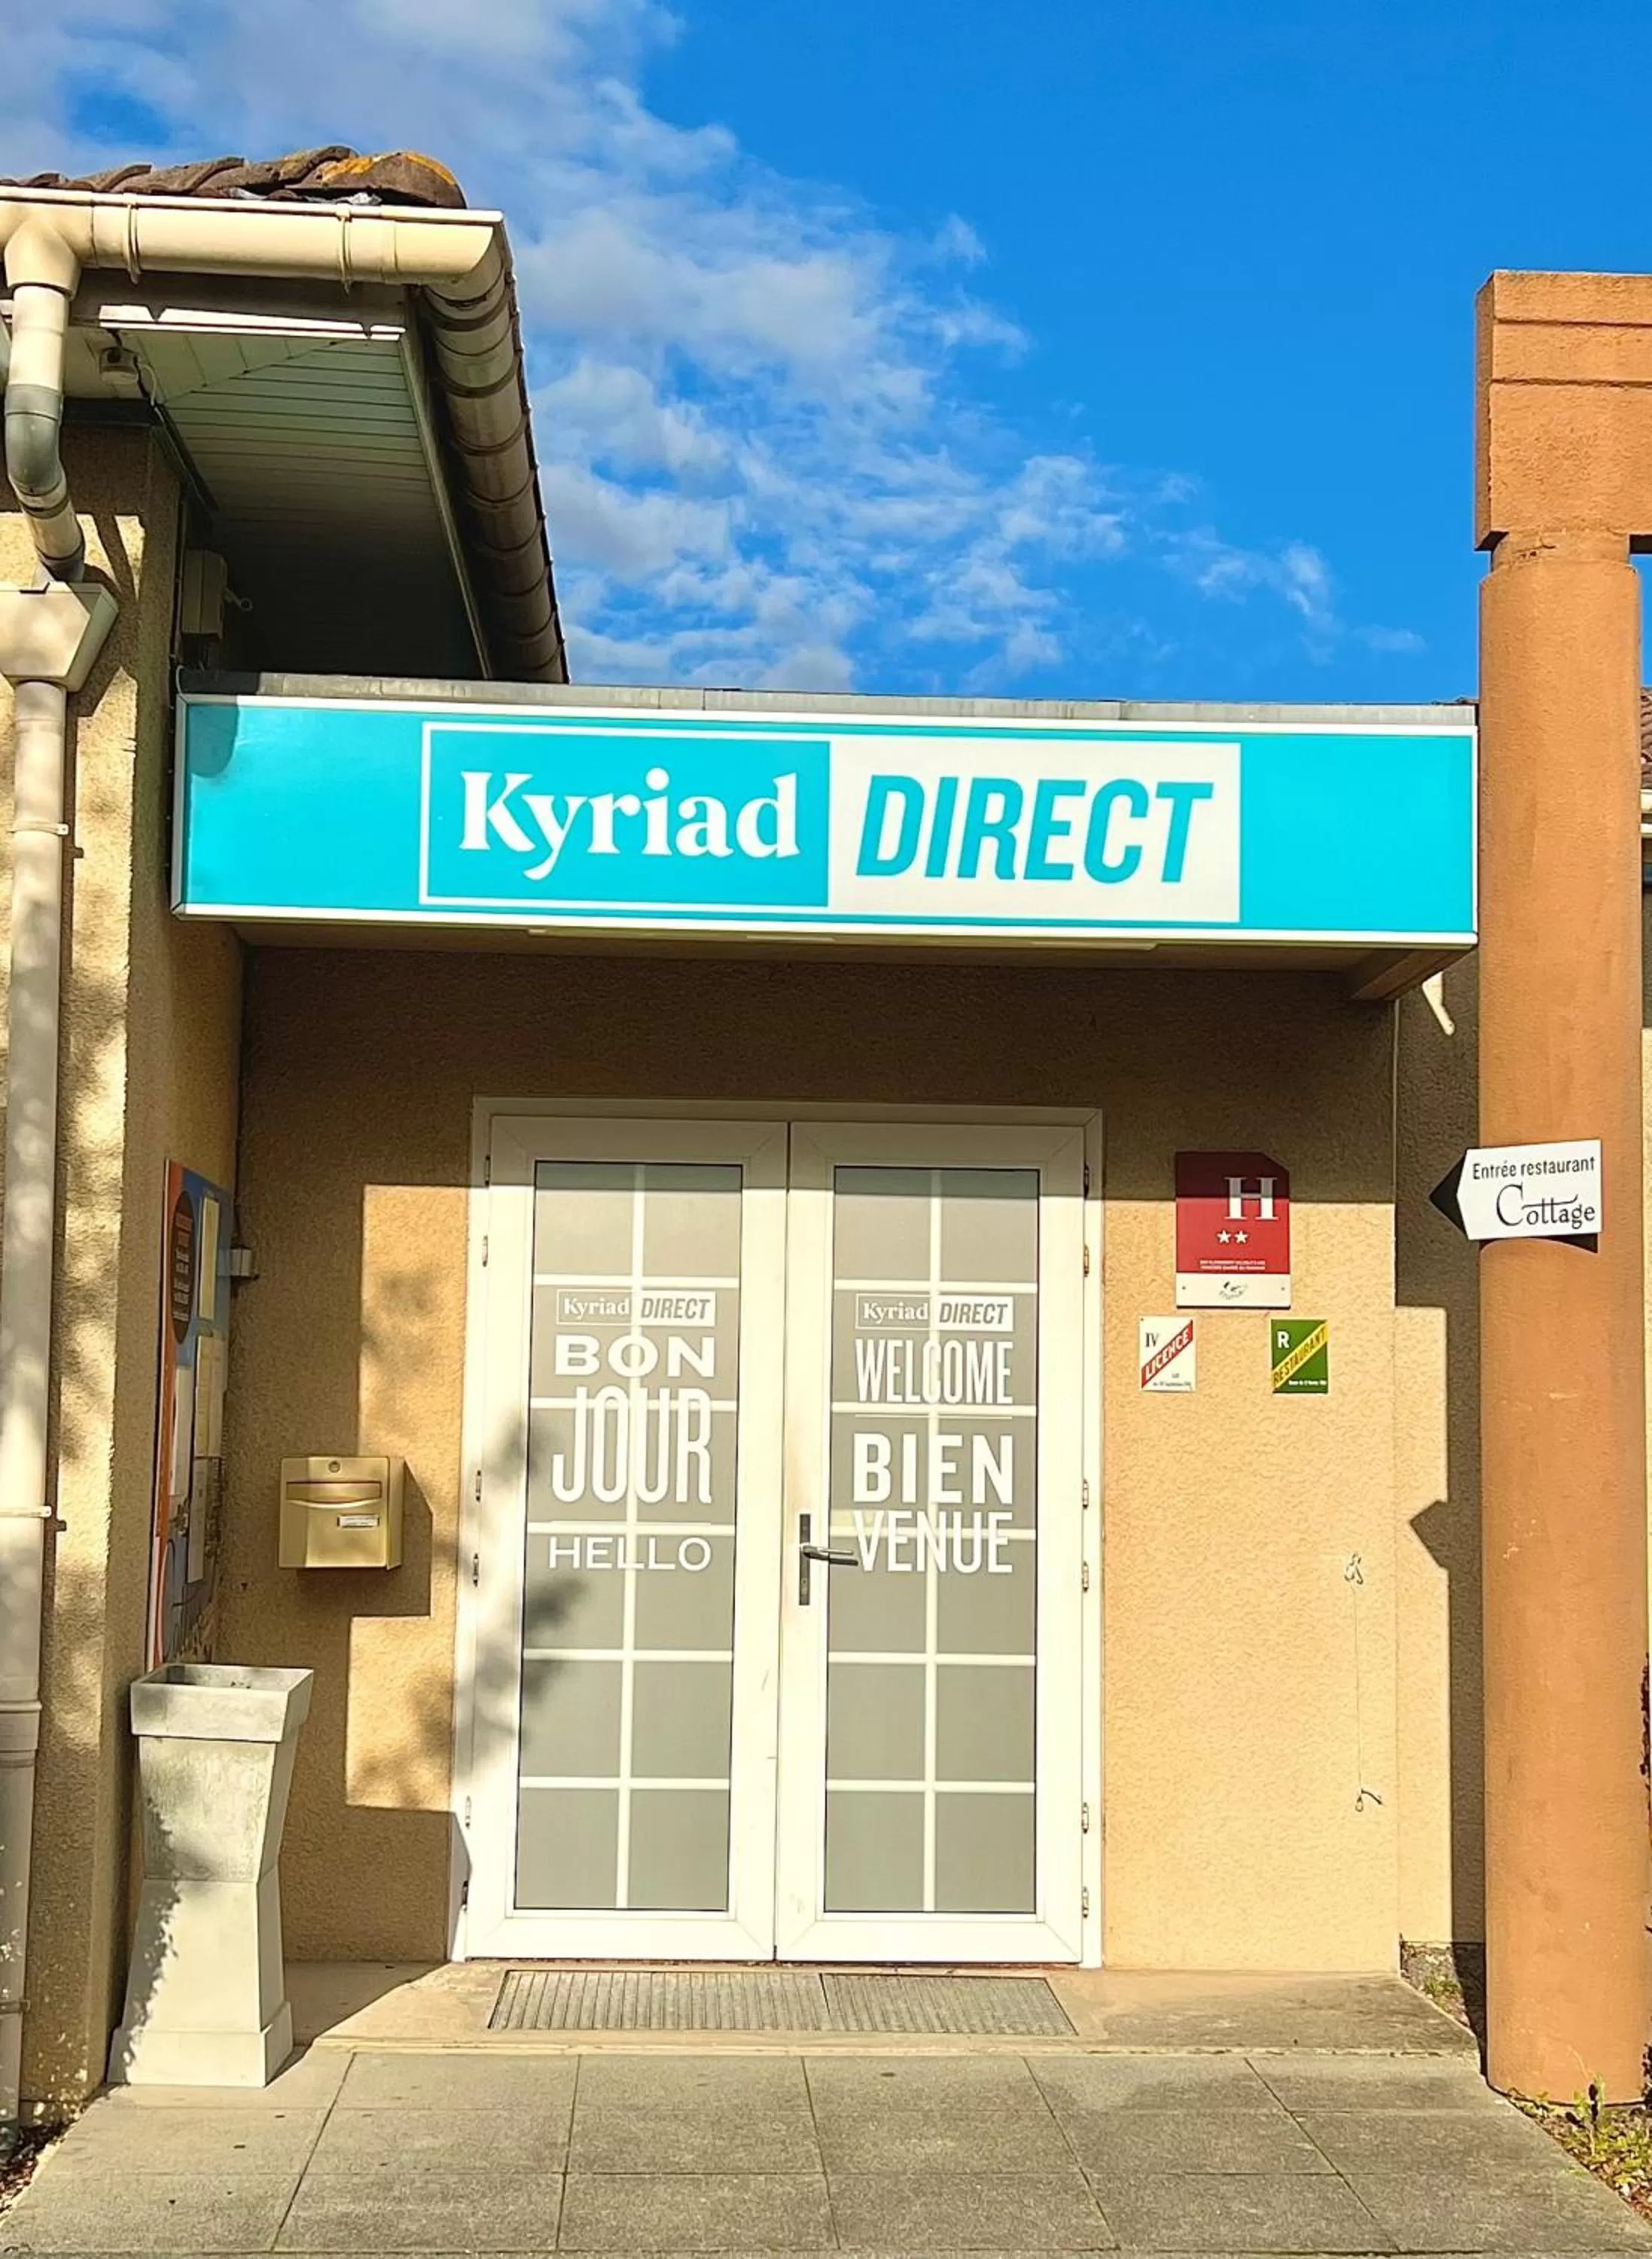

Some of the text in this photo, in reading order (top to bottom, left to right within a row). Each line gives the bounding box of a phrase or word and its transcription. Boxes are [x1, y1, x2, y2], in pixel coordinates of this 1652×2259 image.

[460, 767, 1213, 885] Kyriad DIRECT
[1473, 1156, 1595, 1180] Entrée restaurant
[1224, 1177, 1279, 1221] H
[1496, 1182, 1596, 1230] Cottage
[564, 1297, 712, 1320] Kyriad DIRECT
[863, 1301, 1008, 1325] Kyriad DIRECT
[554, 1334, 715, 1377] BON
[1145, 1332, 1160, 1347] IV
[1145, 1328, 1190, 1381] LICENCE
[1273, 1326, 1326, 1387] RESTAURANT
[1277, 1331, 1289, 1349] R
[855, 1338, 1013, 1404] WELCOME
[552, 1385, 712, 1503] JOUR
[853, 1433, 1013, 1504] BIEN
[549, 1537, 712, 1572] HELLO
[853, 1510, 1013, 1573] VENUE
